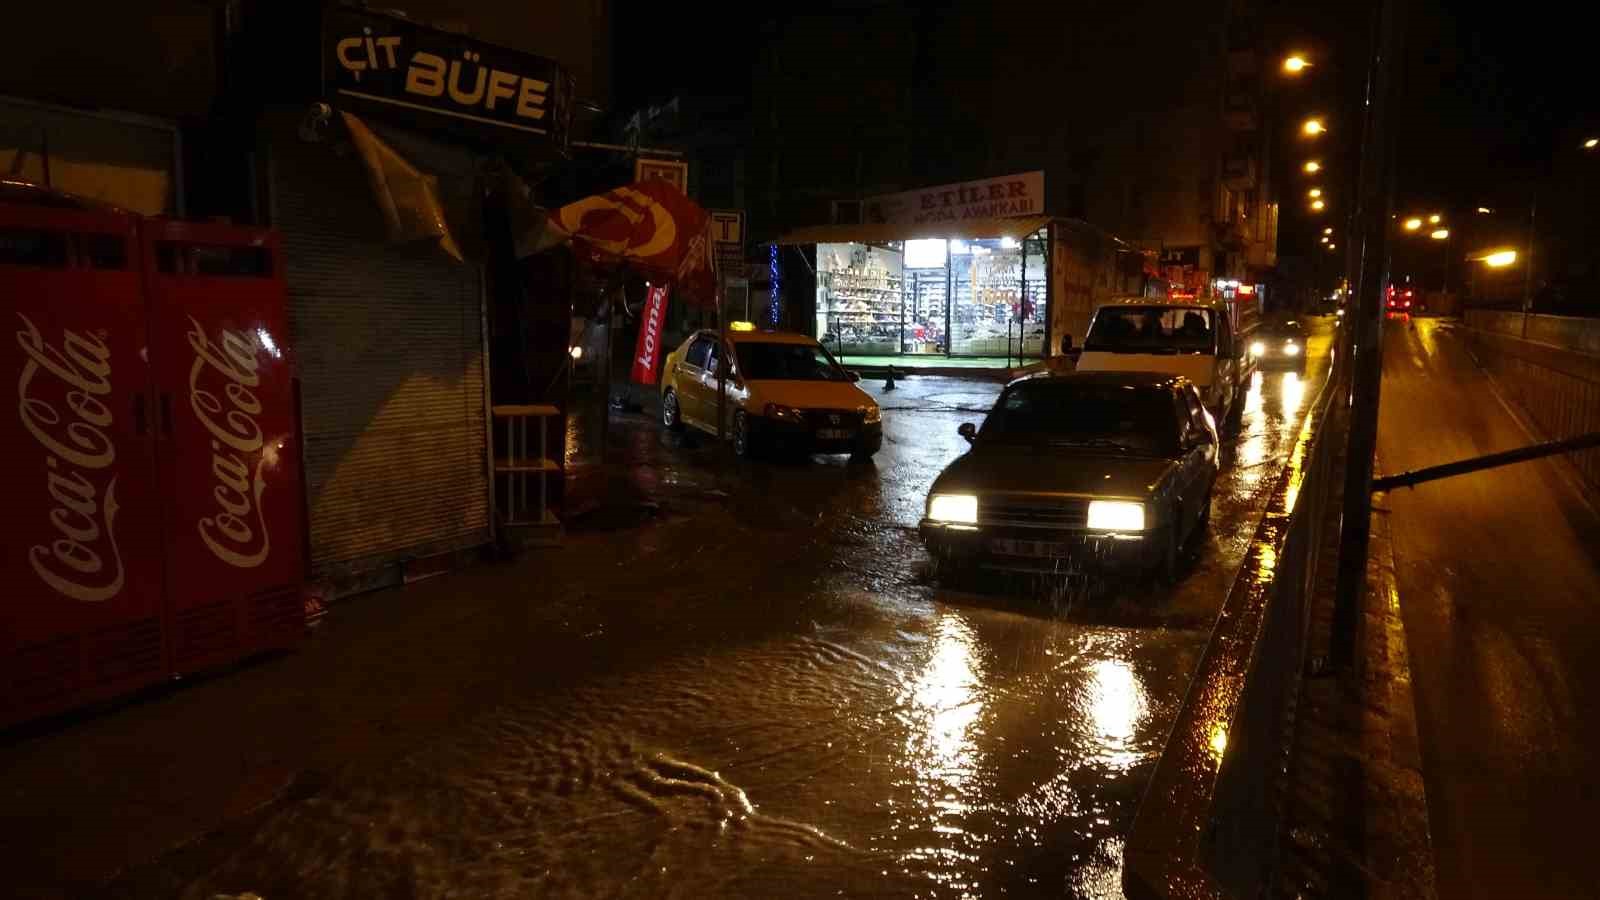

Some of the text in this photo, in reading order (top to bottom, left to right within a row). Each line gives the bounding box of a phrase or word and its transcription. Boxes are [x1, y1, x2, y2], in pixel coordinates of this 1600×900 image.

[337, 26, 550, 119] ÇİT BÜFE
[16, 311, 125, 602] Coca-Cola
[186, 311, 271, 567] Coca-Cola
